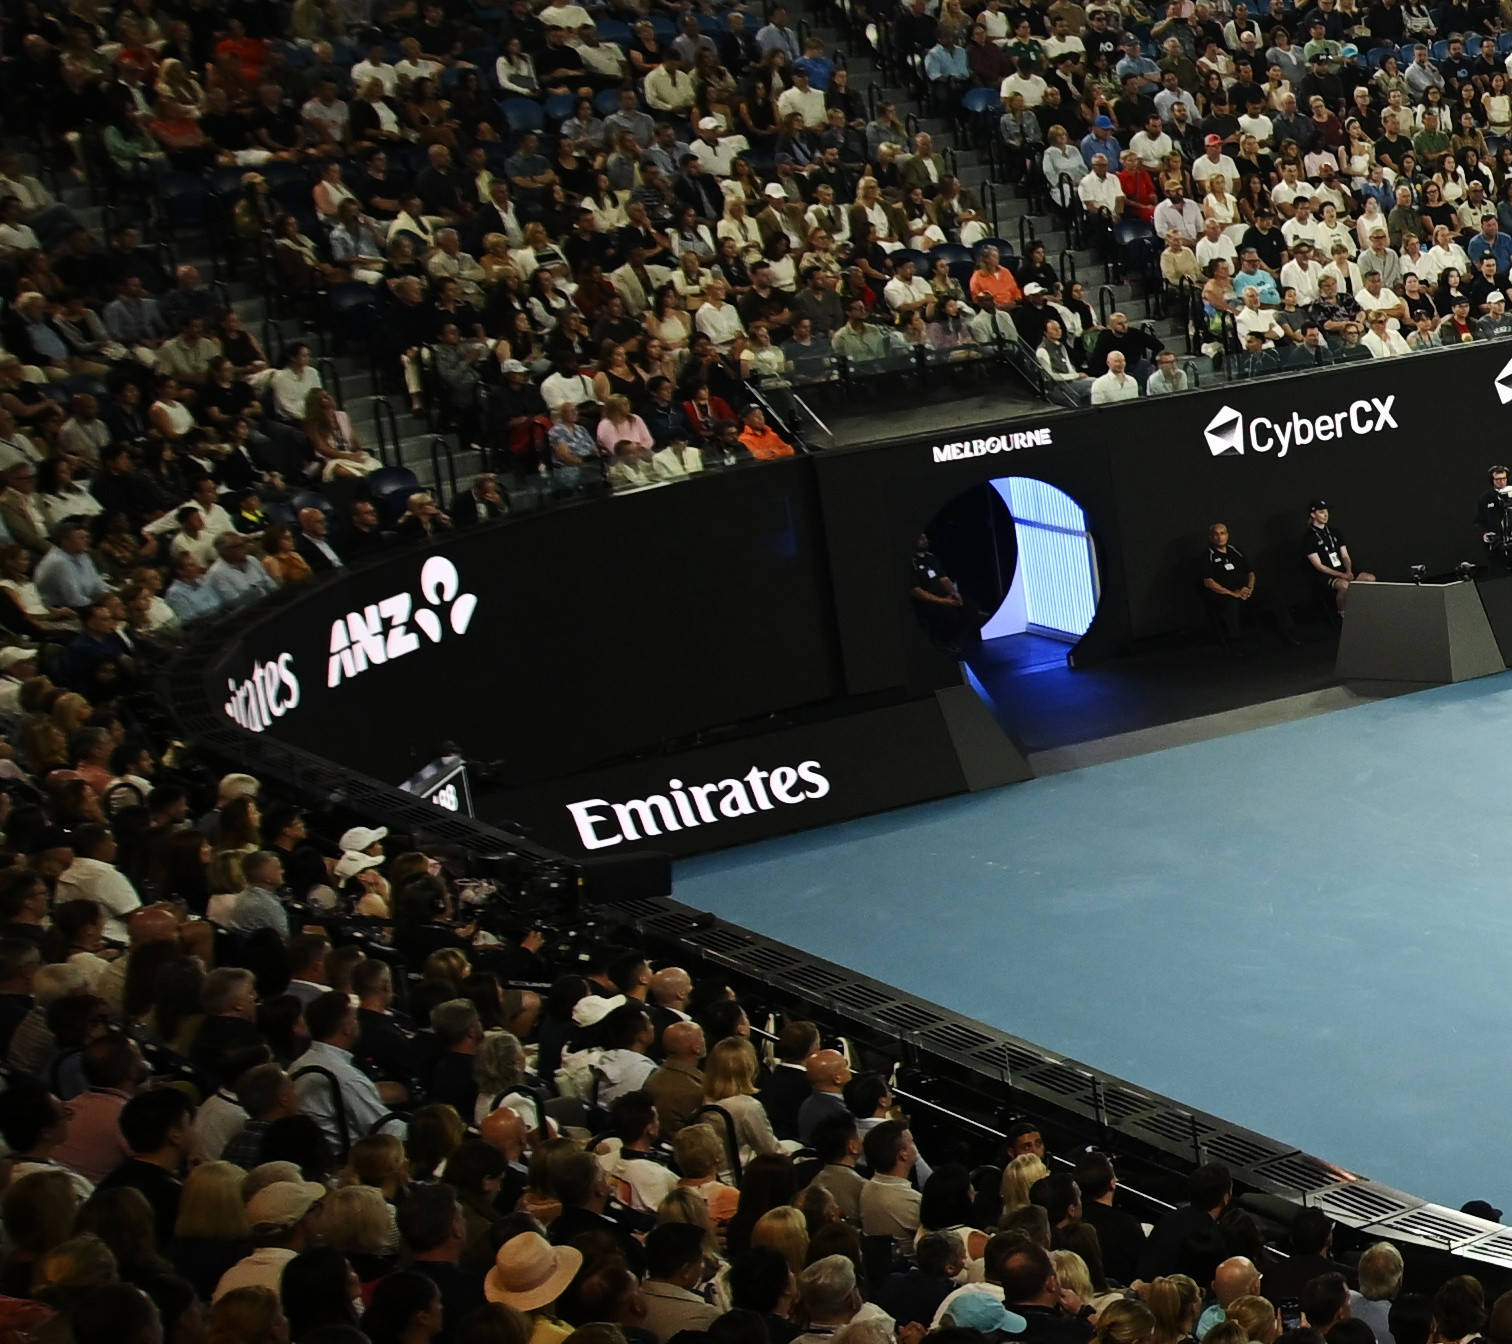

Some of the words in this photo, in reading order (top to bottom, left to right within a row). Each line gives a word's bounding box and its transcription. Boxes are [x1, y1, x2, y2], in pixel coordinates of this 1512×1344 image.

[933, 428, 1053, 463] MELBOURNE
[1250, 395, 1399, 458] CyberCX
[328, 592, 420, 688] ANZ
[566, 761, 830, 850] Emirates
